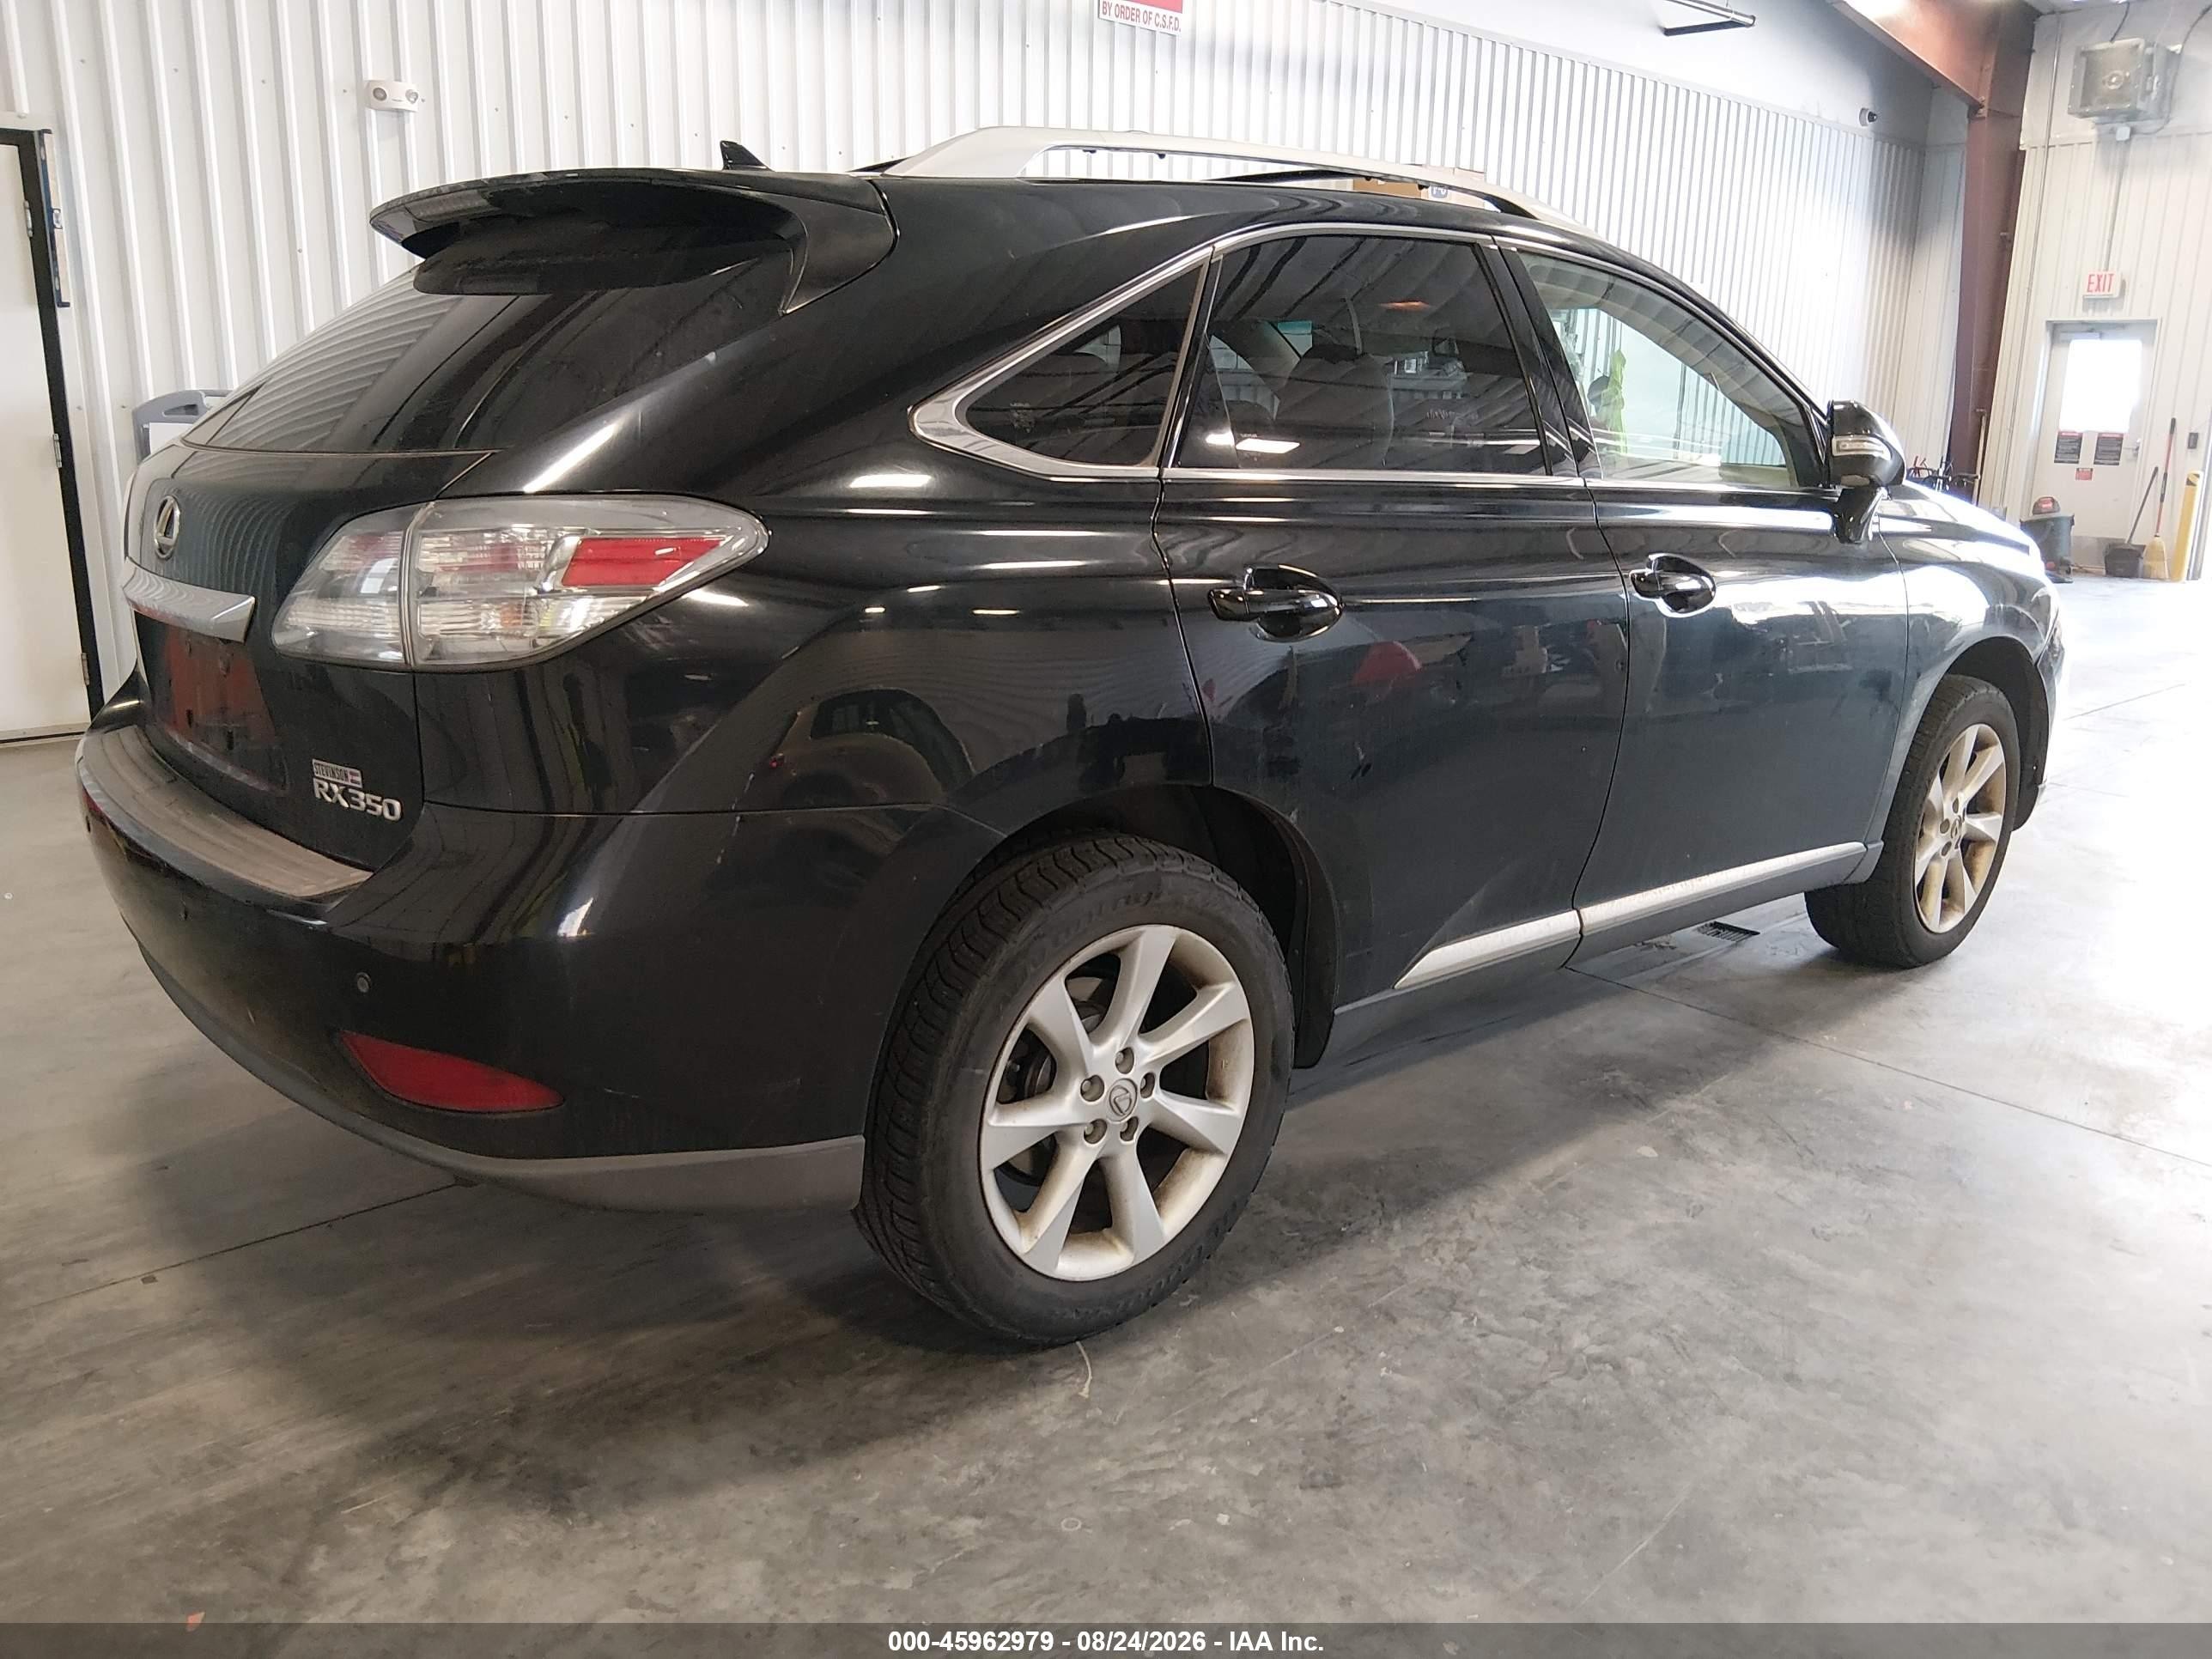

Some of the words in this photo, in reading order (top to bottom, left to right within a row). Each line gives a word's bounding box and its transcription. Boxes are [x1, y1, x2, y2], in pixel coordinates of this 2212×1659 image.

[1102, 1, 1113, 16] BY
[1115, 3, 1140, 23] ORDER
[1143, 9, 1153, 26] OF
[1154, 13, 1182, 33] C.S.F.D.
[2087, 272, 2115, 293] EXIT
[313, 777, 403, 822] RX350
